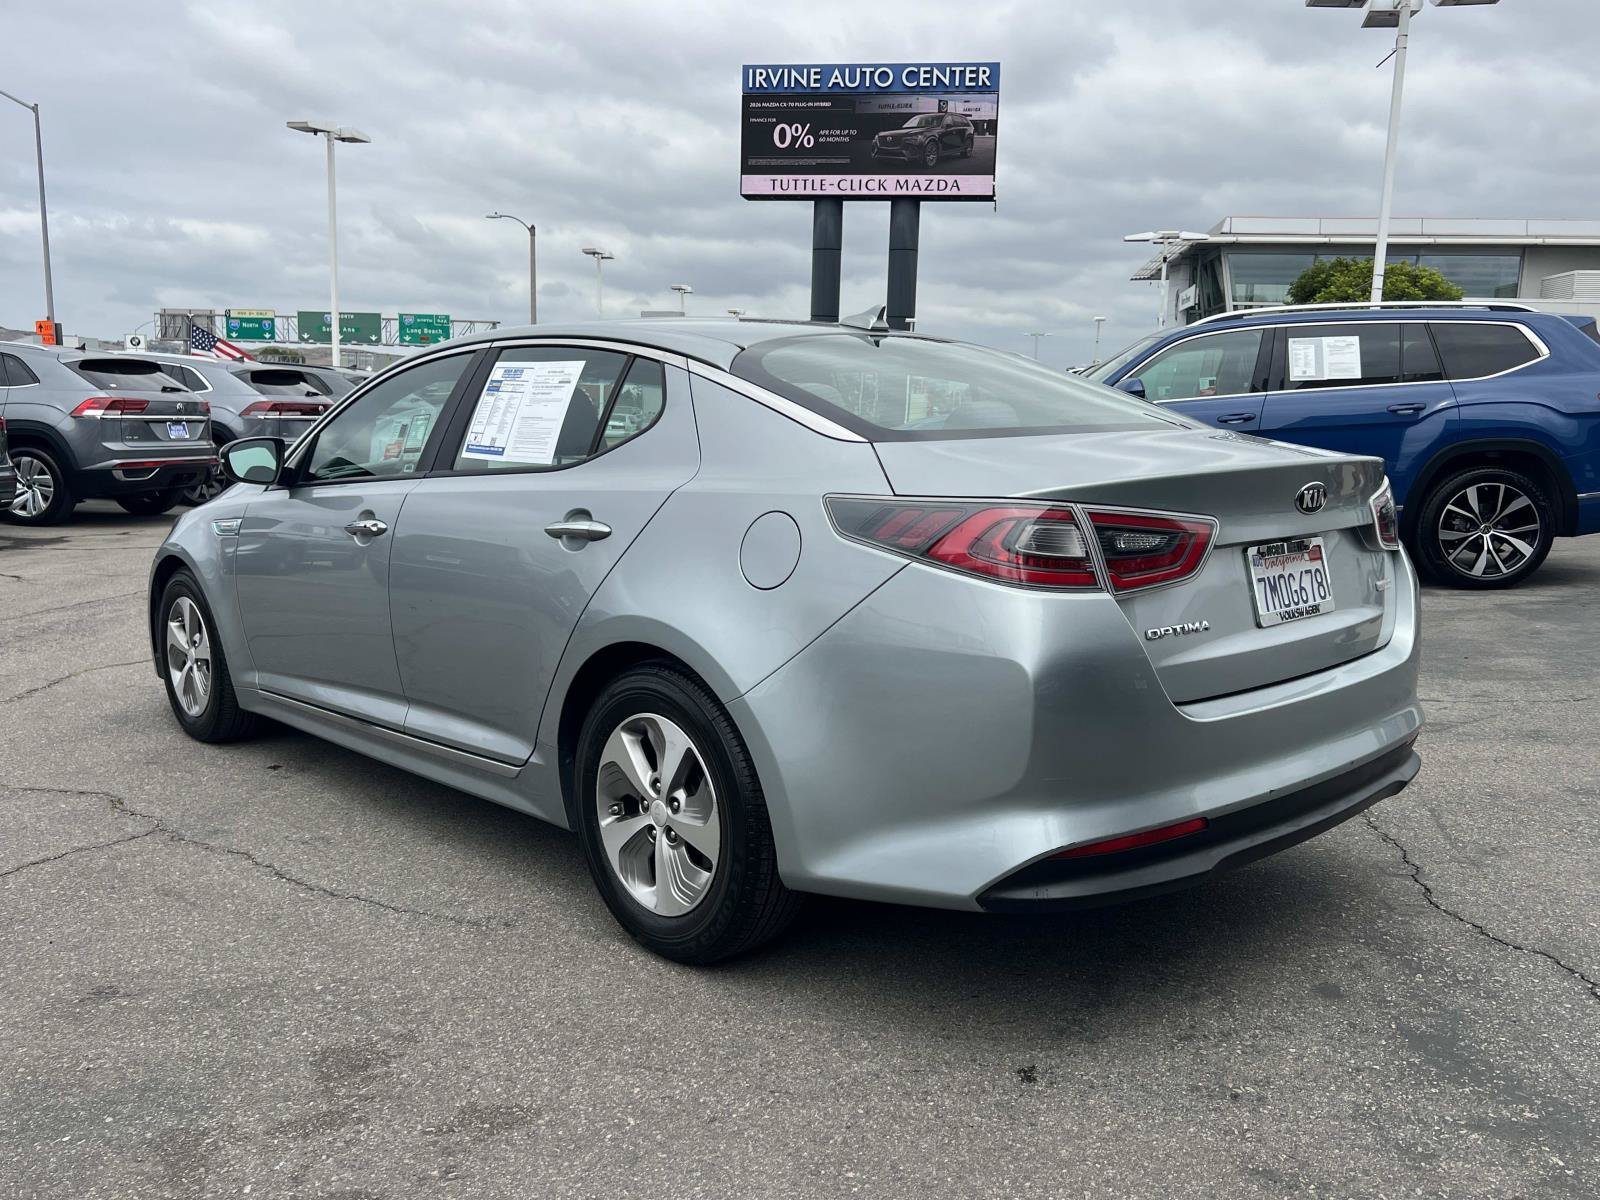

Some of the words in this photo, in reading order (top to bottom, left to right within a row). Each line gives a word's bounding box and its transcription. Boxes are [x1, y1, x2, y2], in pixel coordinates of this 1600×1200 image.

[748, 67, 821, 88] IRVINE
[828, 66, 894, 88] AUTO
[902, 66, 991, 87] CENTER
[773, 122, 815, 149] 0%
[770, 178, 888, 192] TUTTLE-CLICK
[895, 178, 961, 192] MAZDA
[1302, 488, 1326, 508] KIA
[1279, 604, 1322, 621] VOLKSWAGEN
[1145, 620, 1210, 640] OPTIMA
